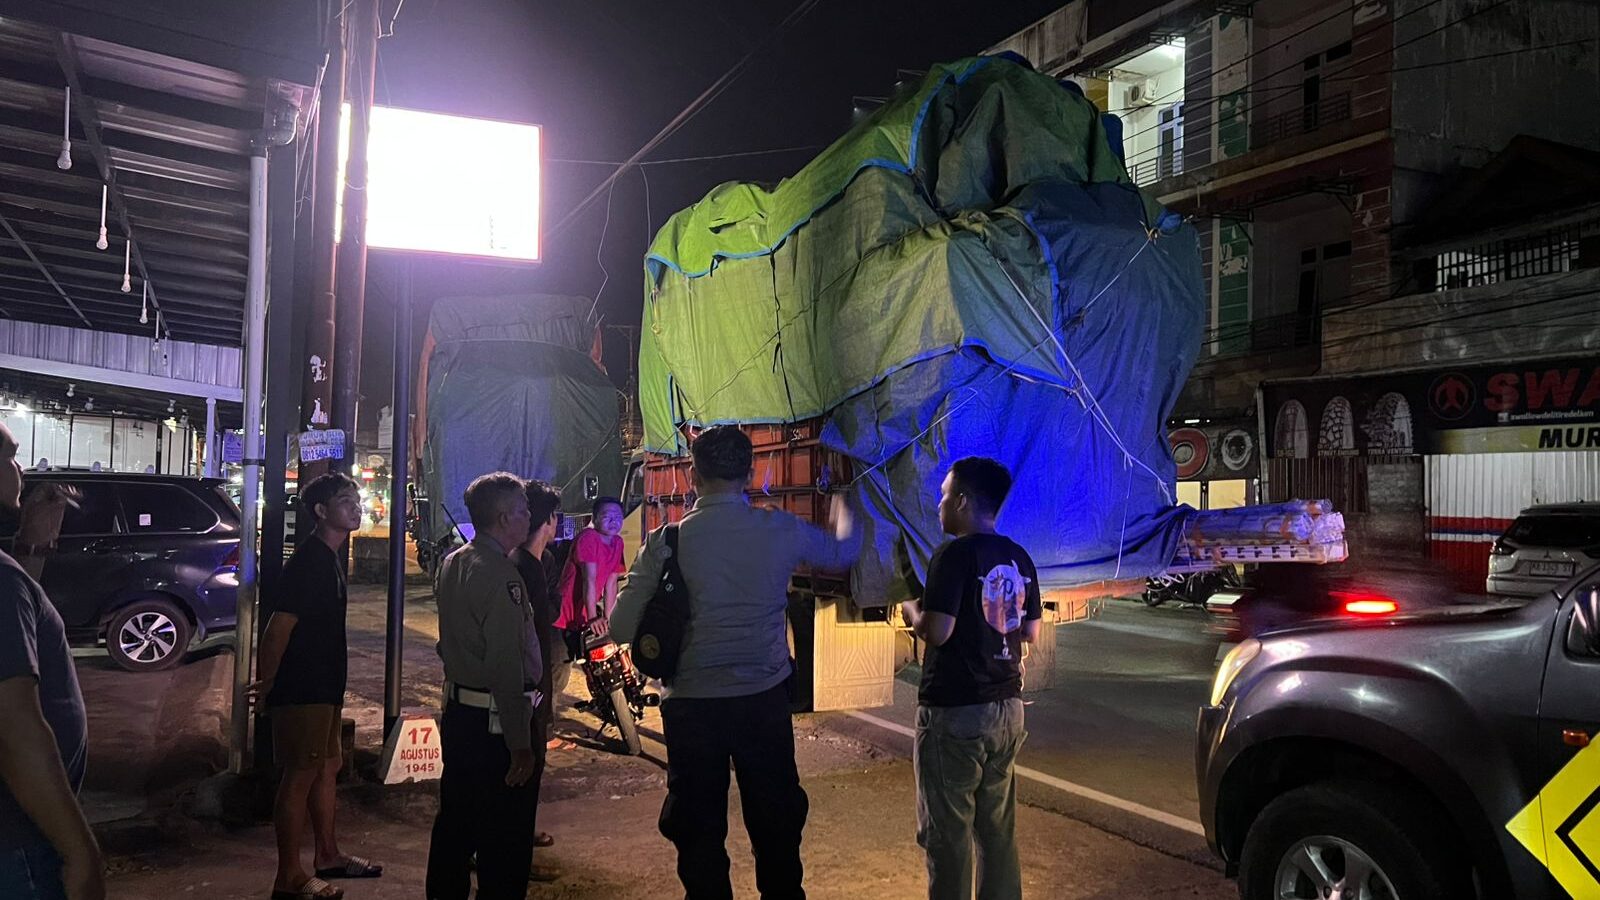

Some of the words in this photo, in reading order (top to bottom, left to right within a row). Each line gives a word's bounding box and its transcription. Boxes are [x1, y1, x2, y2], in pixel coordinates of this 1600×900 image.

[1539, 427, 1600, 449] MUR
[408, 727, 432, 745] 17
[400, 748, 439, 760] AGUSTUS
[405, 763, 435, 773] 1945
